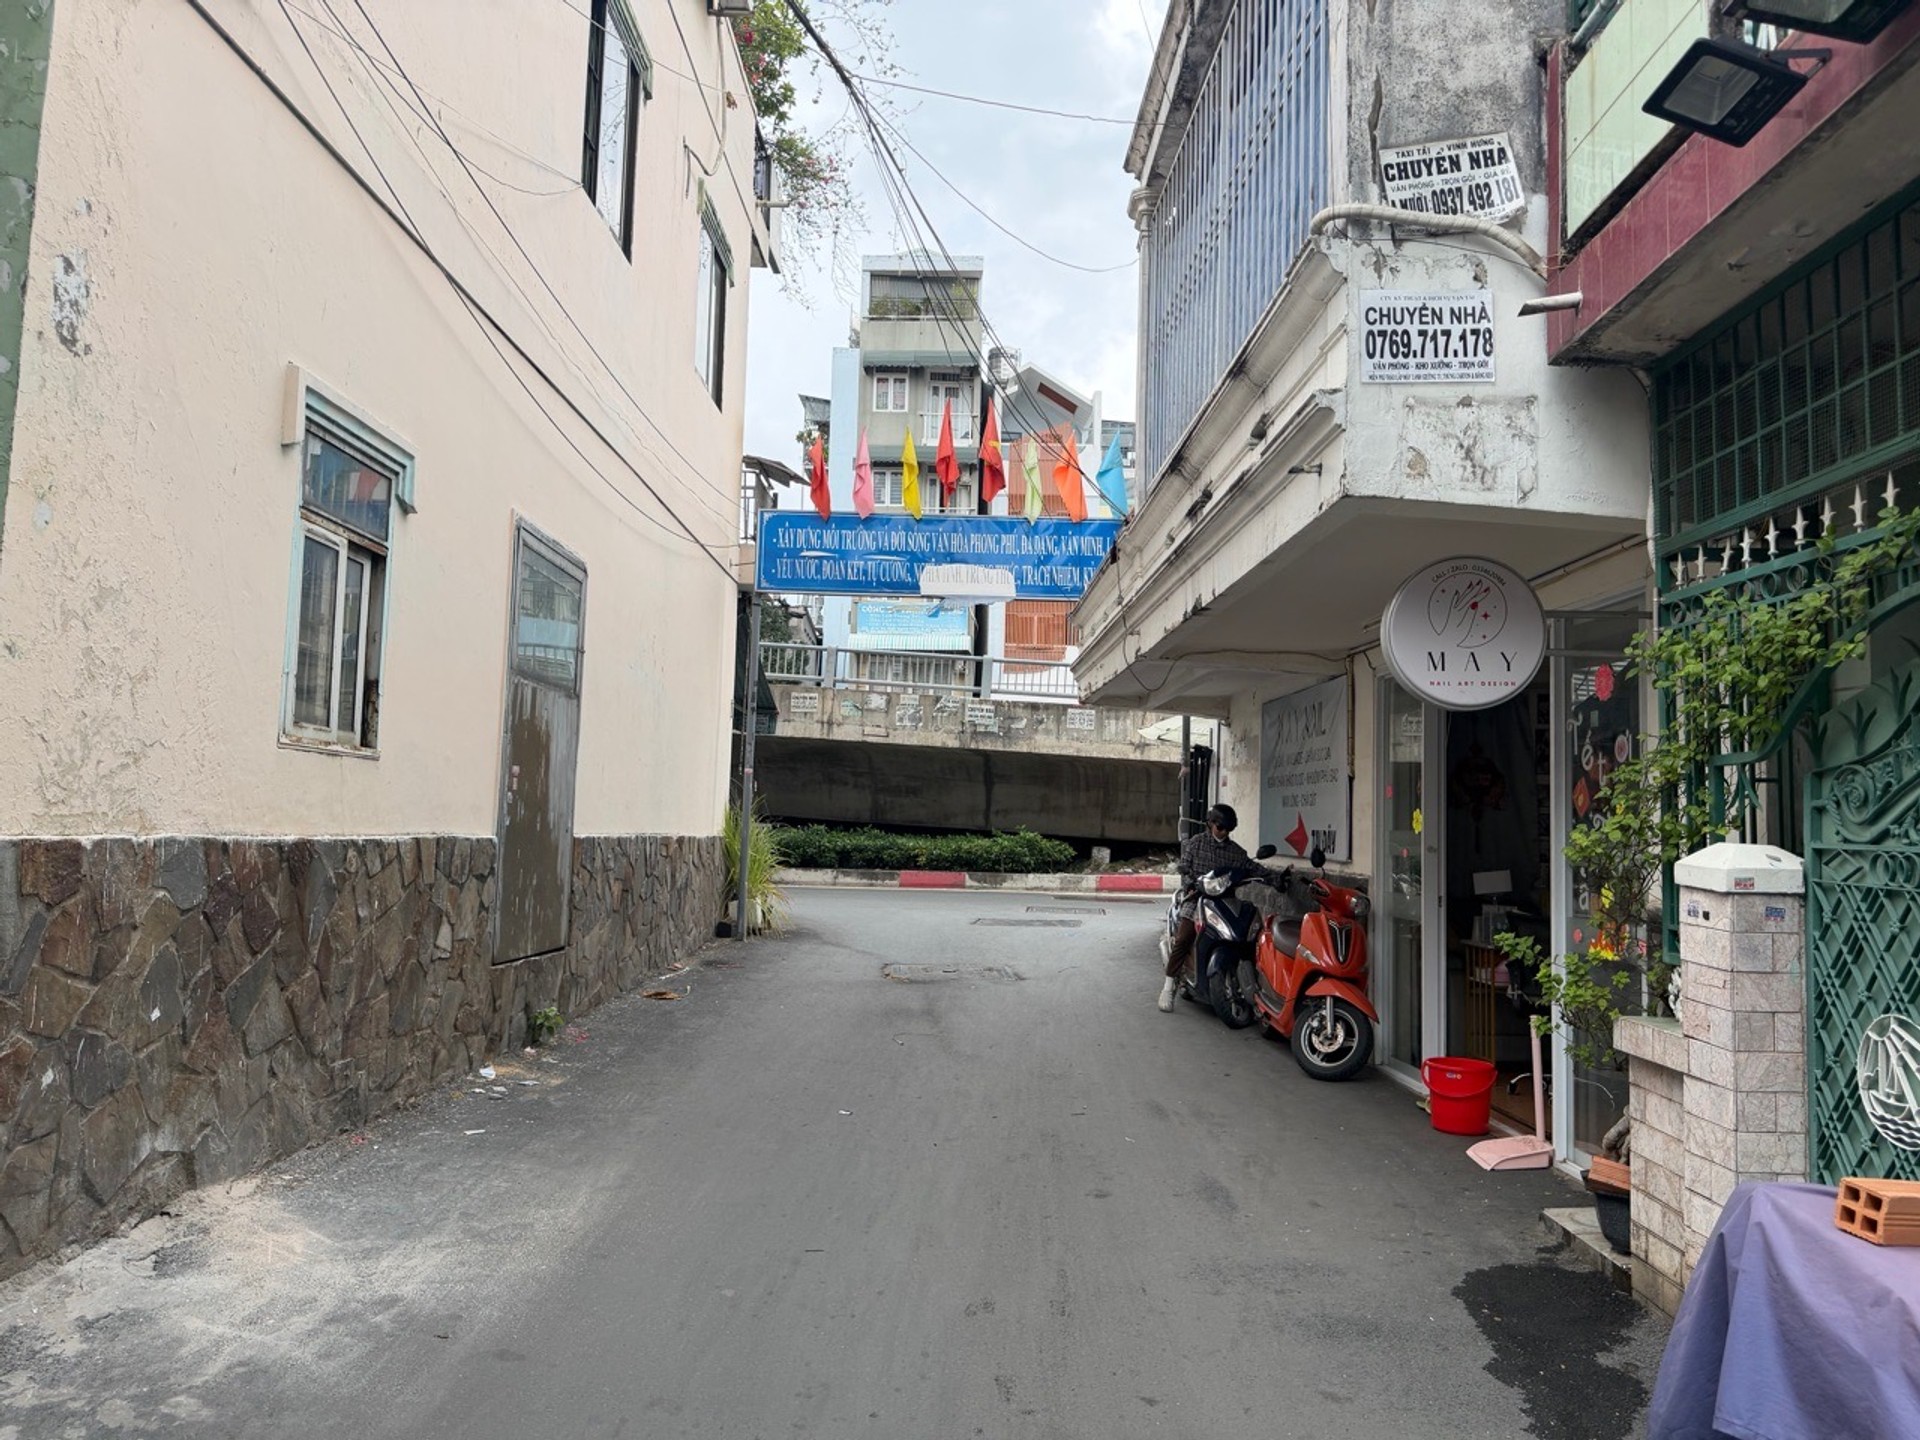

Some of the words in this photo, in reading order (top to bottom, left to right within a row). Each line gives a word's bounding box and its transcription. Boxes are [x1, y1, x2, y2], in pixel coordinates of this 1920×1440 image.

[1395, 149, 1415, 159] TAXI
[1468, 141, 1511, 171] NHÀ
[1365, 302, 1443, 325] CHUYỂN
[1450, 301, 1491, 325] NHÀ
[1365, 327, 1494, 359] 0769.717.178
[970, 533, 999, 554] PHONG
[1022, 560, 1050, 586] TRÁCH
[1427, 651, 1518, 672] MAY
